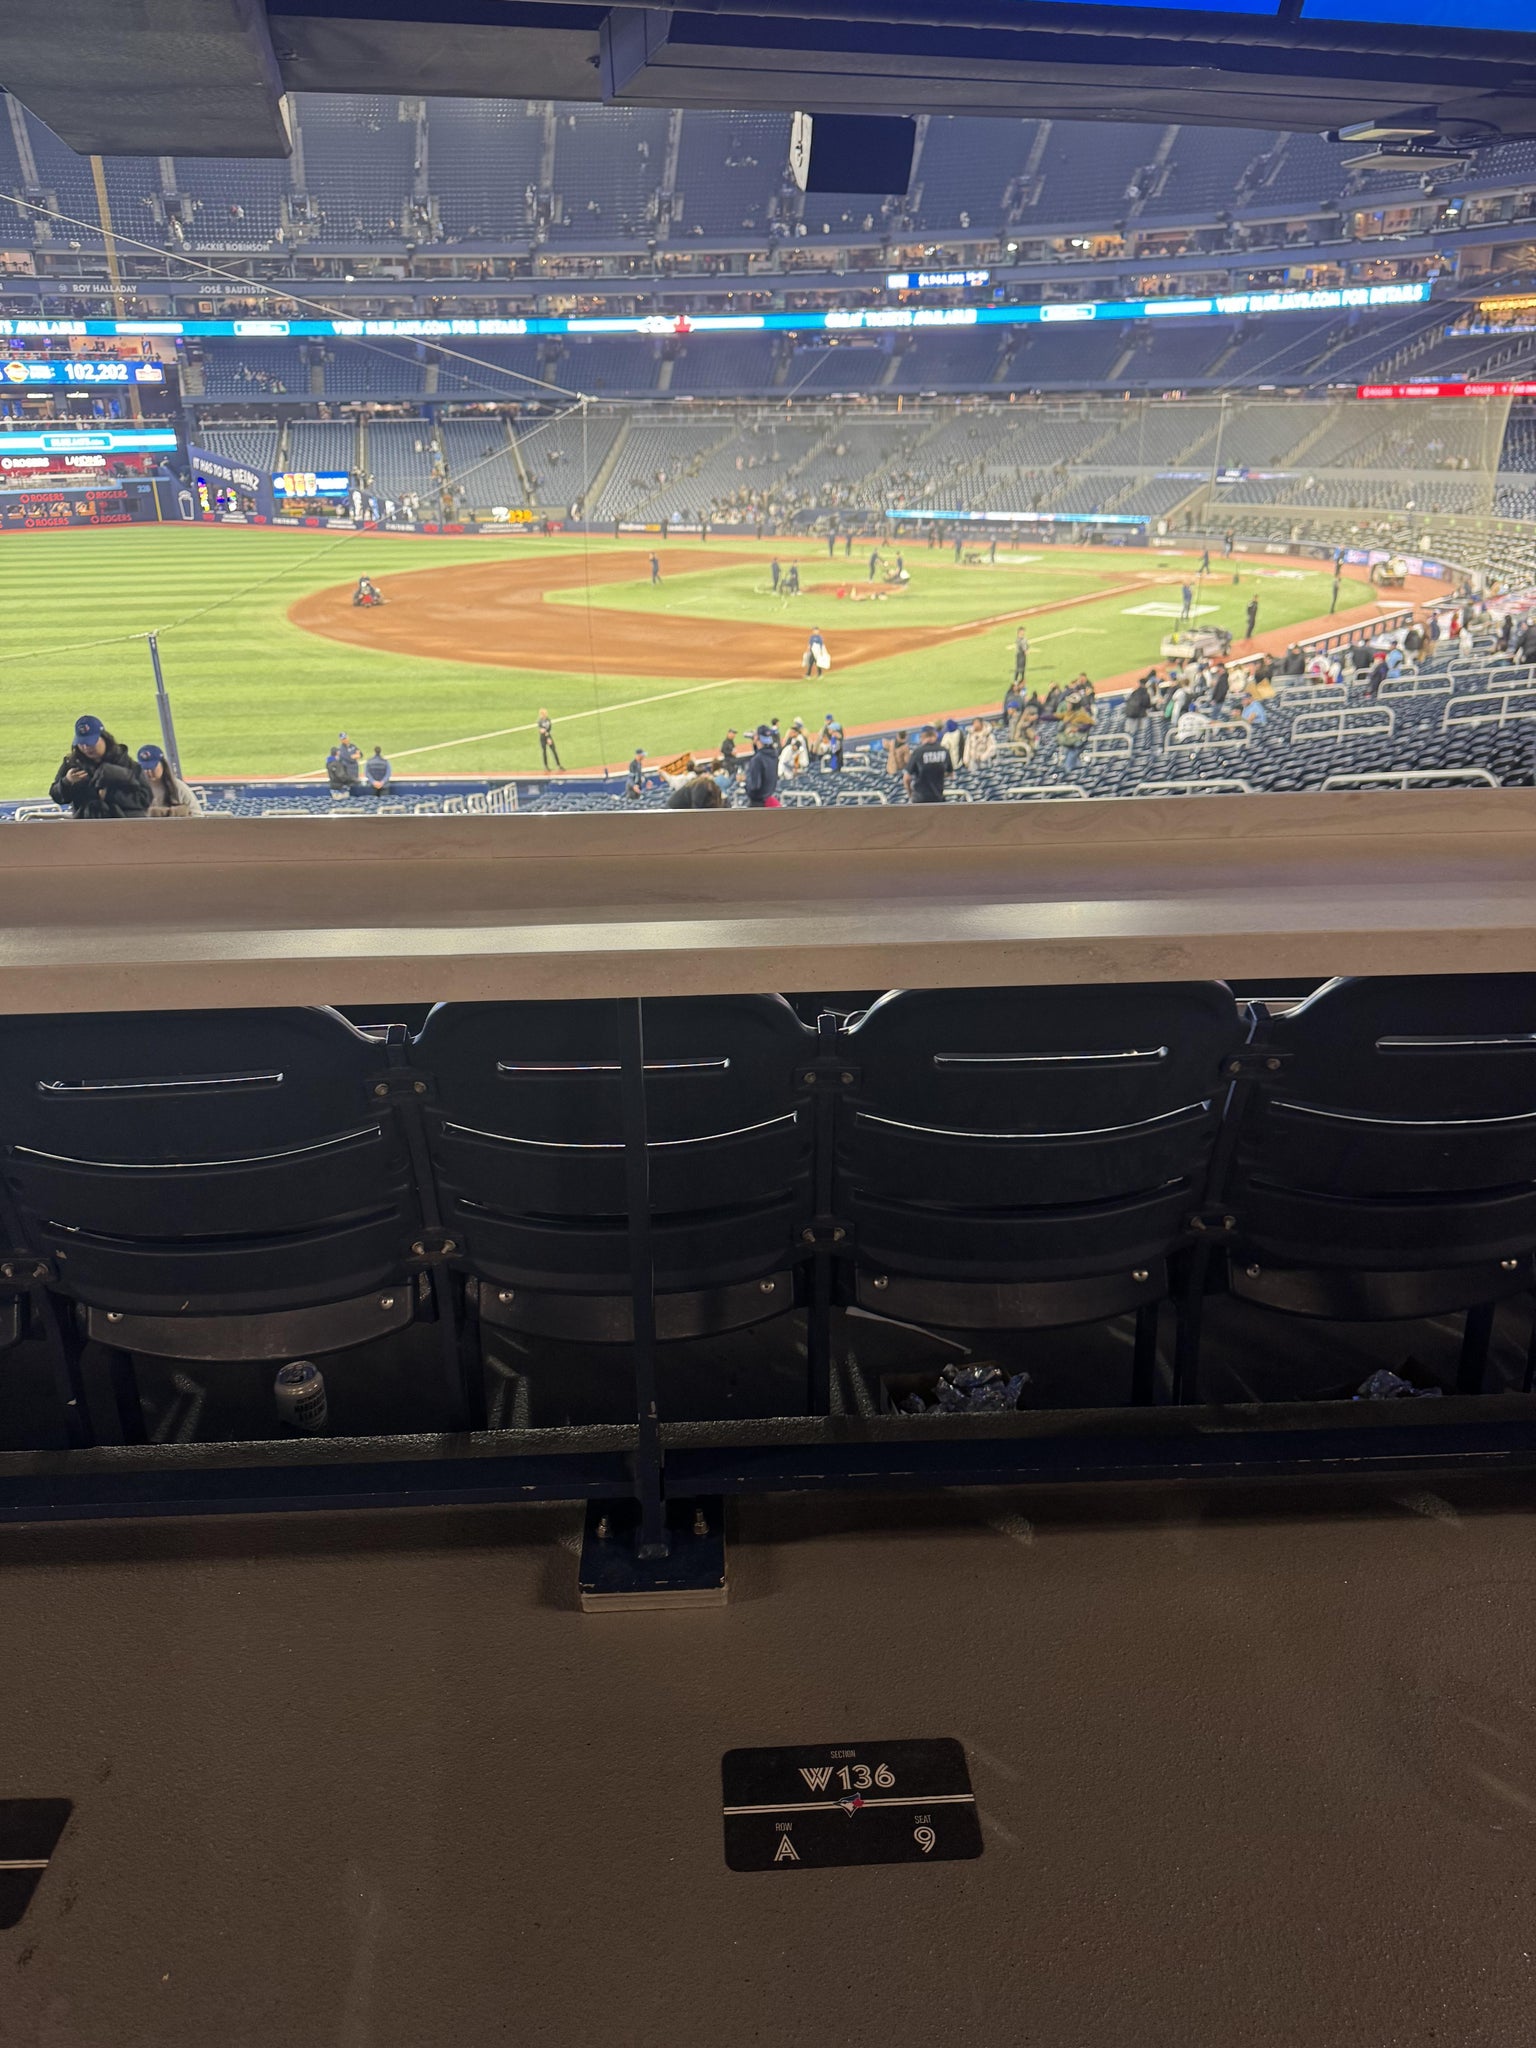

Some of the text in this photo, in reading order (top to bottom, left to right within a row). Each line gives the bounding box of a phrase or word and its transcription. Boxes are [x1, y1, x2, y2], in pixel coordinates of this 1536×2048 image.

[196, 243, 224, 252] JACKIE
[226, 243, 270, 252] ROBINSON
[72, 284, 91, 293] ROY
[93, 284, 137, 293] HALLADAY
[199, 284, 267, 294] JOSÉ BAUTISTA
[64, 363, 128, 382] 102,202
[213, 463, 223, 478] TO
[231, 468, 260, 491] HEINZ
[29, 493, 65, 502] ROGERS
[95, 490, 128, 500] ROGERS
[35, 517, 69, 527] ROGERS
[100, 514, 132, 525] ROGERS
[923, 751, 946, 764] STAFF
[830, 1749, 856, 1760] SECTION
[798, 1763, 896, 1791] W136
[914, 1814, 932, 1825] SEAT
[775, 1822, 793, 1832] ROW
[913, 1826, 936, 1854] 9
[774, 1833, 801, 1862] A
